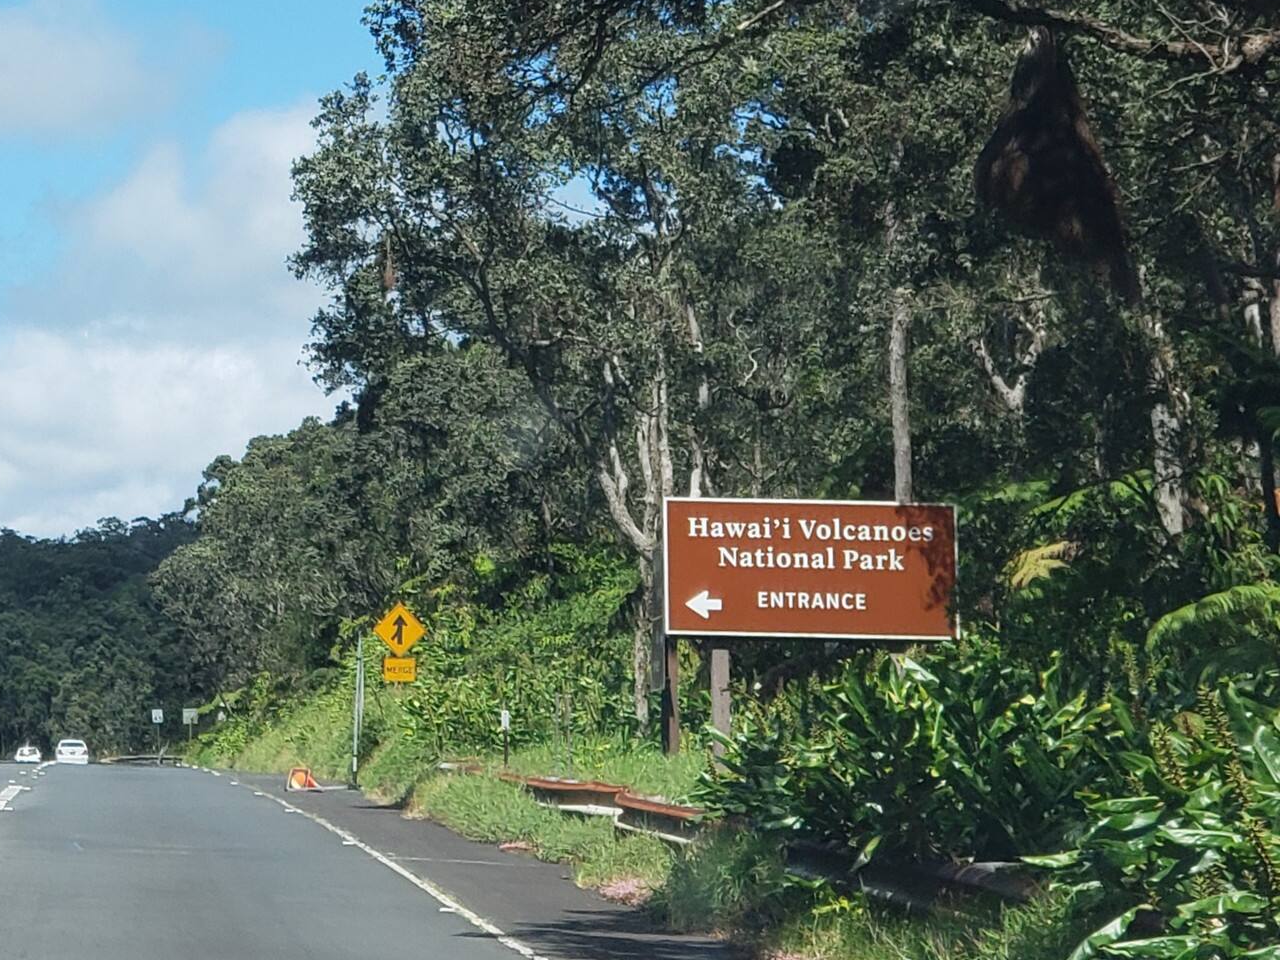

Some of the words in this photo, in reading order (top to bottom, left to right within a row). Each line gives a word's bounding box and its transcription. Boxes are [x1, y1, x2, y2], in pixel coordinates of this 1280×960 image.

[798, 518, 934, 542] Volcanoes
[718, 547, 835, 569] National
[842, 549, 905, 571] Park
[757, 591, 867, 610] ENTRANCE
